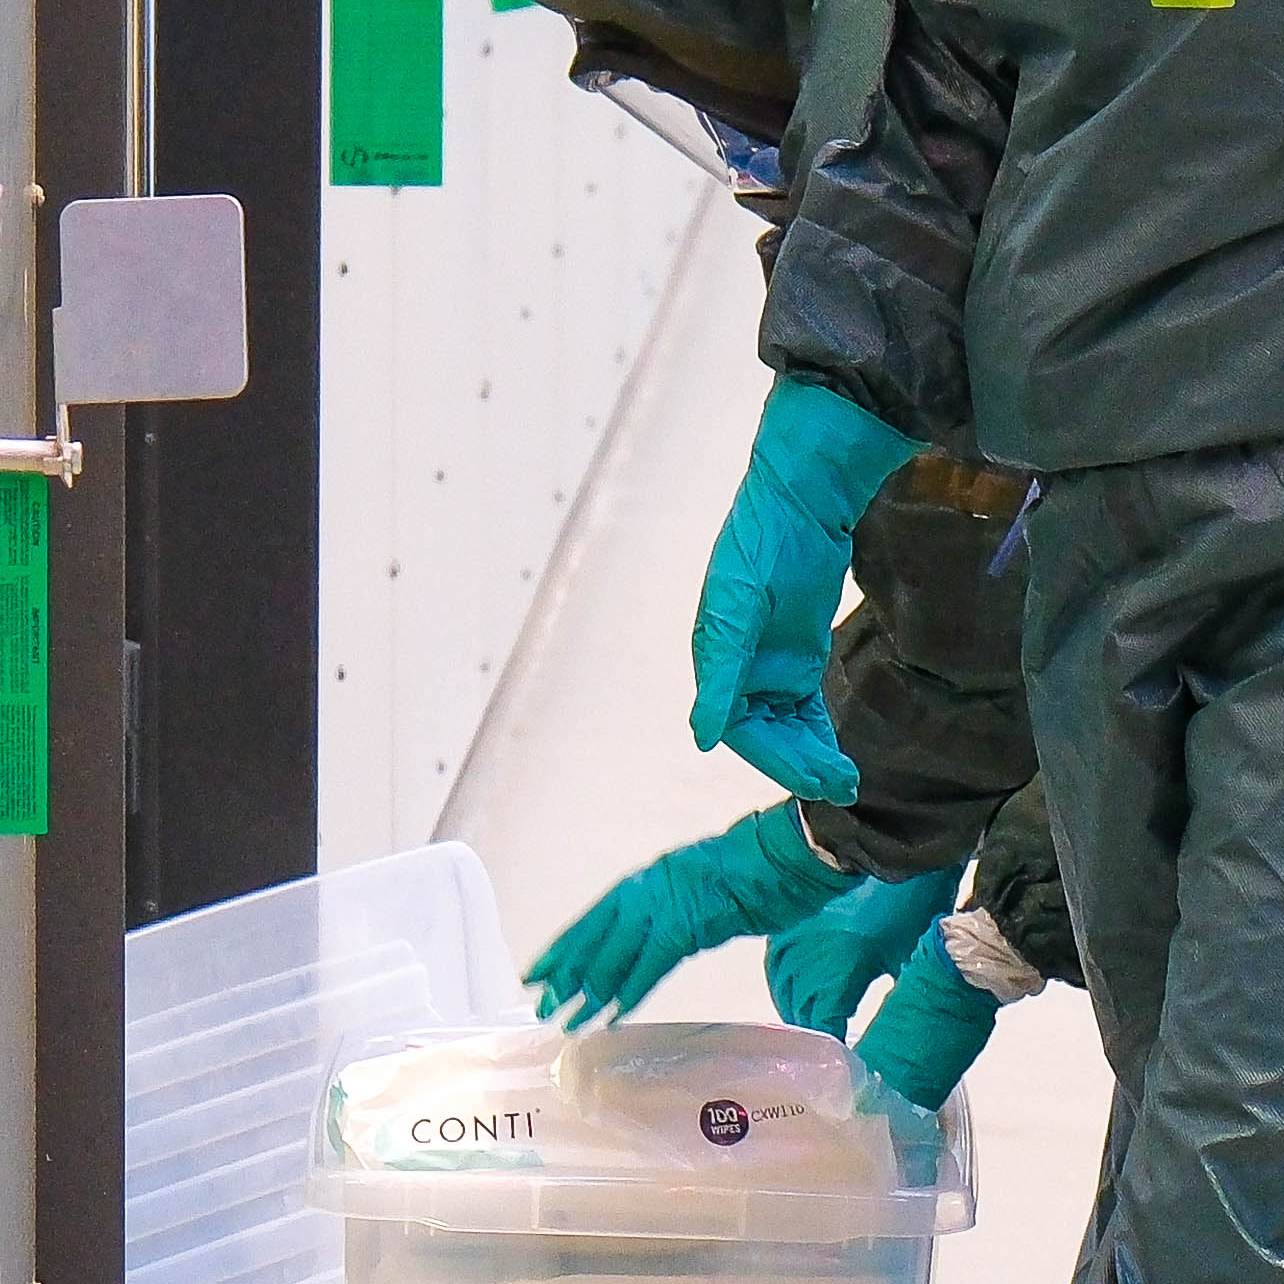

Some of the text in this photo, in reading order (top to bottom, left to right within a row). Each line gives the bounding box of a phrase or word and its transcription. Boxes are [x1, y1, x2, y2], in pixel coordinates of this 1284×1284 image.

[707, 1106, 739, 1125] 100
[411, 1111, 533, 1144] CONTI
[710, 1123, 741, 1135] WIPES
